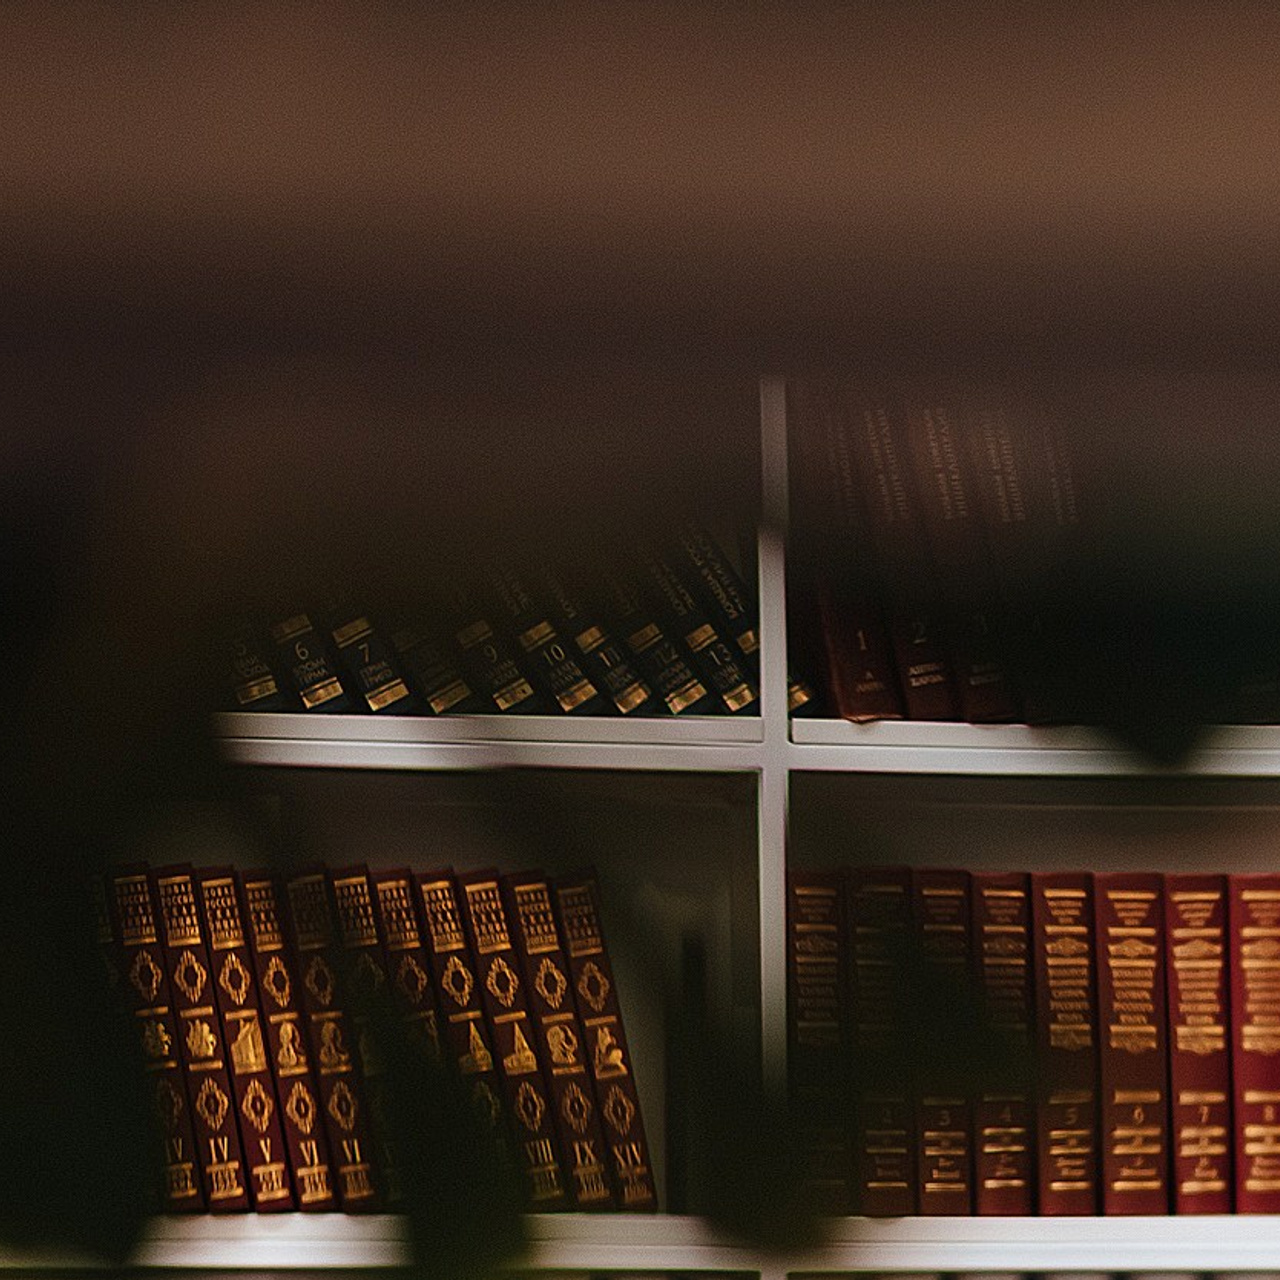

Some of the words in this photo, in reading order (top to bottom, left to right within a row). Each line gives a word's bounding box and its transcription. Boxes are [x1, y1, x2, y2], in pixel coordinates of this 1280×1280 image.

[294, 640, 309, 661] 6
[857, 630, 868, 651] 1
[357, 642, 371, 663] 7
[543, 643, 566, 665] 10
[939, 1110, 951, 1125] 3
[1065, 1109, 1078, 1125] 5
[1132, 1105, 1144, 1124] 6
[1199, 1105, 1211, 1123] 7
[1263, 1104, 1275, 1122] 8
[208, 1135, 228, 1163] IV
[258, 1136, 271, 1163] V
[299, 1138, 319, 1165] VI
